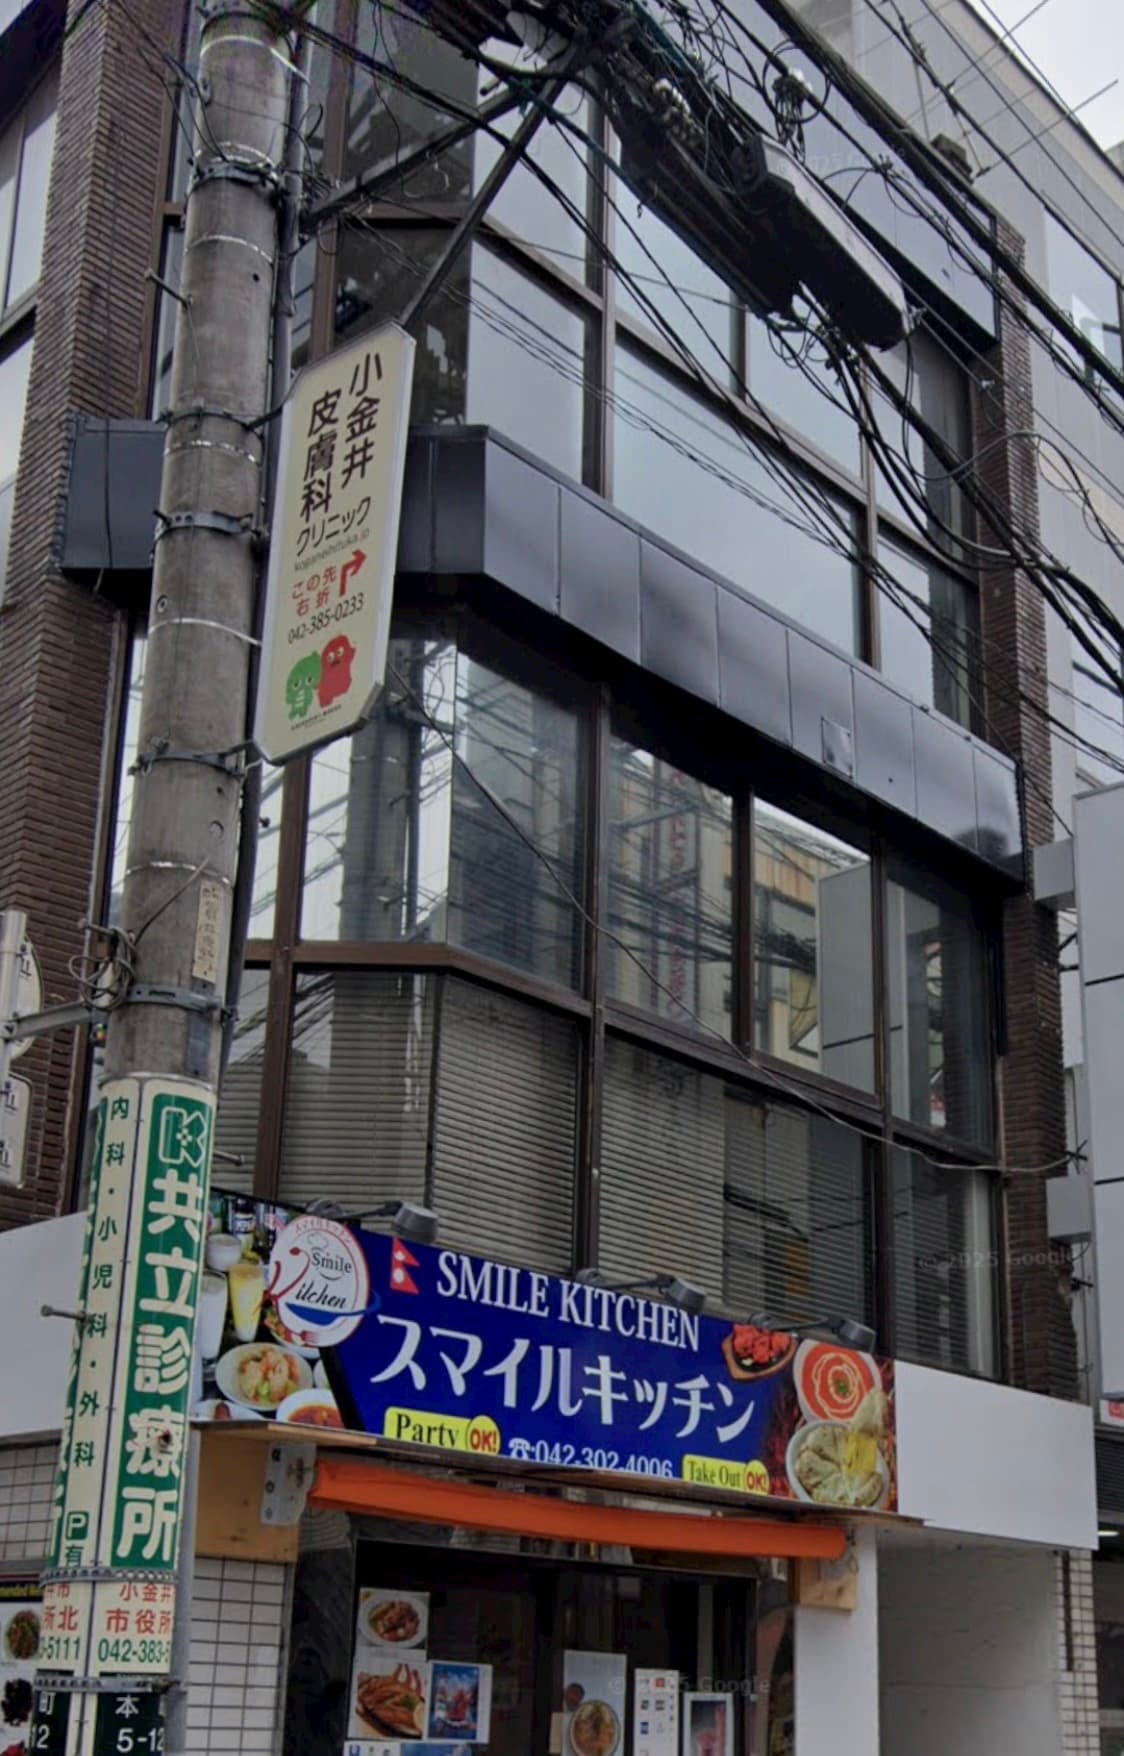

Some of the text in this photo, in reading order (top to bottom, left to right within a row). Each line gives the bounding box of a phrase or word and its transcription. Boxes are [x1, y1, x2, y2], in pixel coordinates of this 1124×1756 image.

[341, 352, 385, 490] 小金井
[299, 386, 343, 525] 皮膚科
[295, 496, 372, 558] クリニック
[290, 564, 338, 600] この先
[295, 585, 331, 618] 右折
[287, 592, 366, 645] 042-385-0233
[311, 1251, 352, 1274] Smile
[436, 1249, 700, 1354] SMILE KITCHEN
[116, 1168, 204, 1561] 共立診療所
[369, 1312, 756, 1444] スマイルキッチン
[396, 1412, 498, 1453] Party OK!
[687, 1460, 768, 1492] Take Out OK!
[105, 1607, 172, 1636] 市役所
